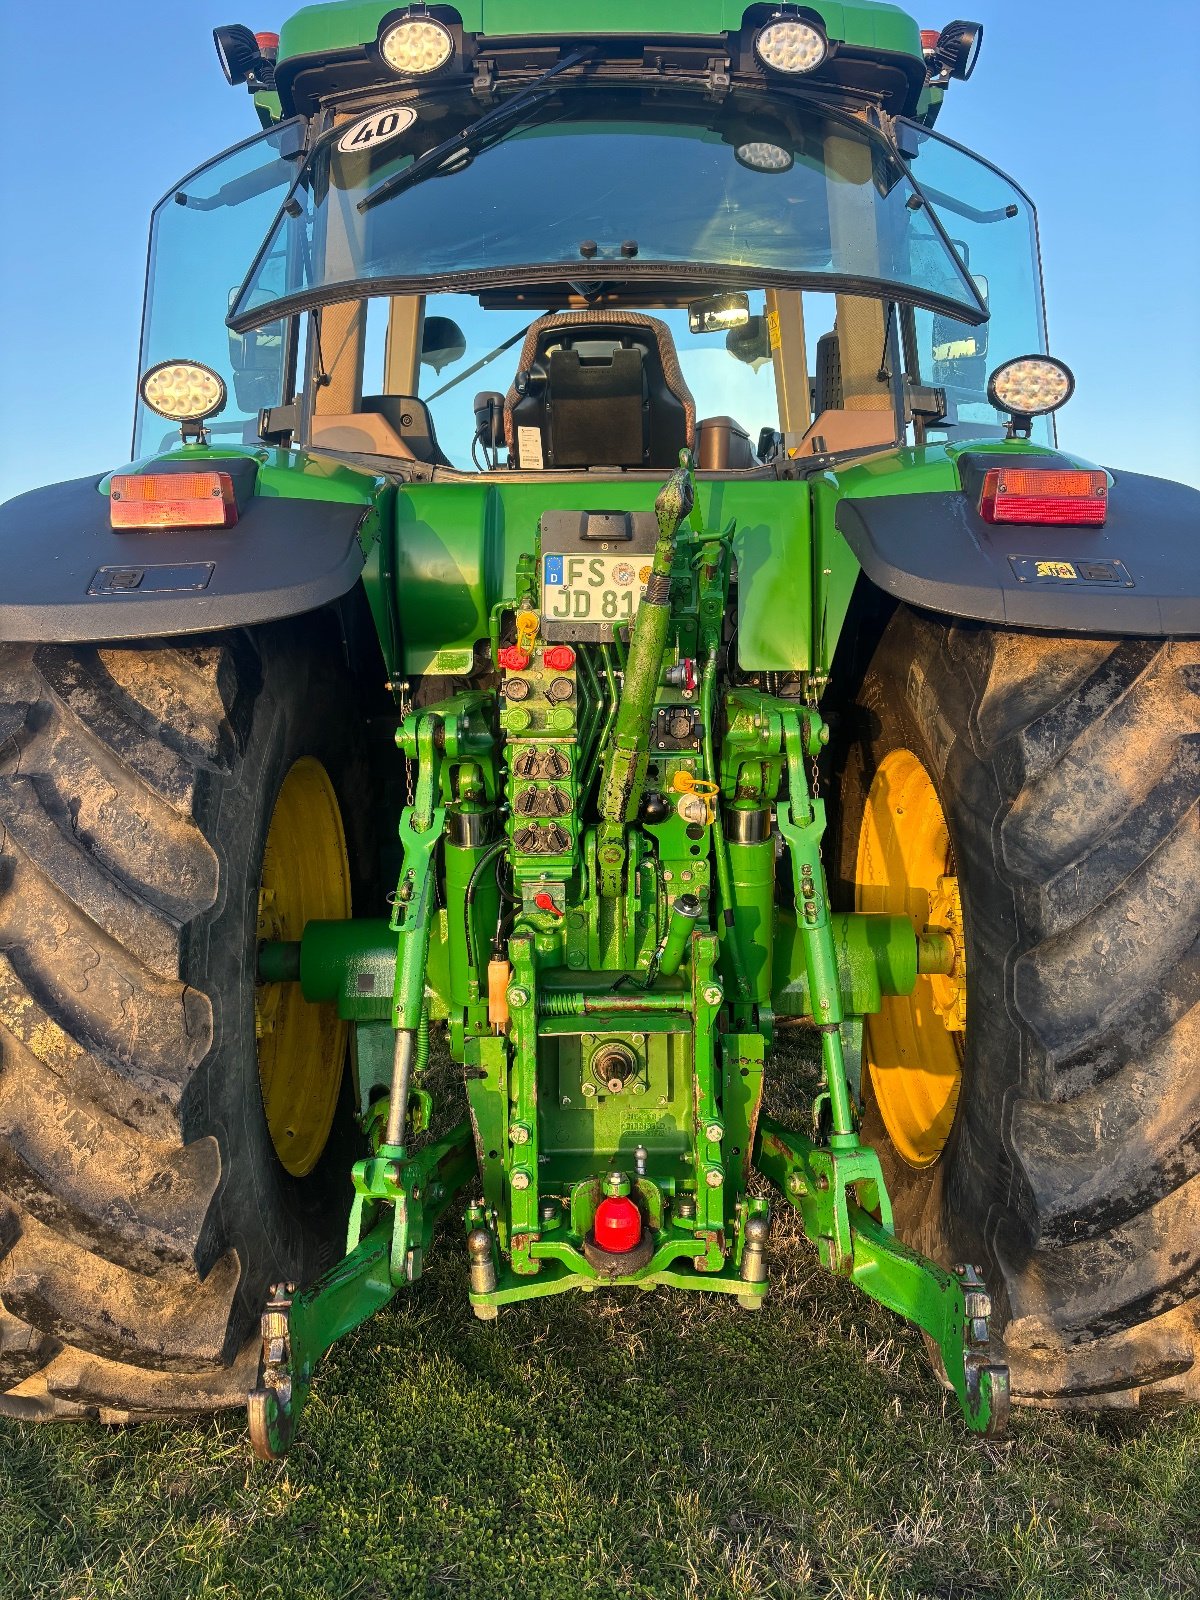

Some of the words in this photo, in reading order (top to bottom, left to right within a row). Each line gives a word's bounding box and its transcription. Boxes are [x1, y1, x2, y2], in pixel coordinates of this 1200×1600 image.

[351, 112, 400, 145] 40
[550, 573, 558, 583] D
[568, 558, 605, 587] FS
[553, 589, 591, 618] JD
[601, 589, 646, 618] 81
